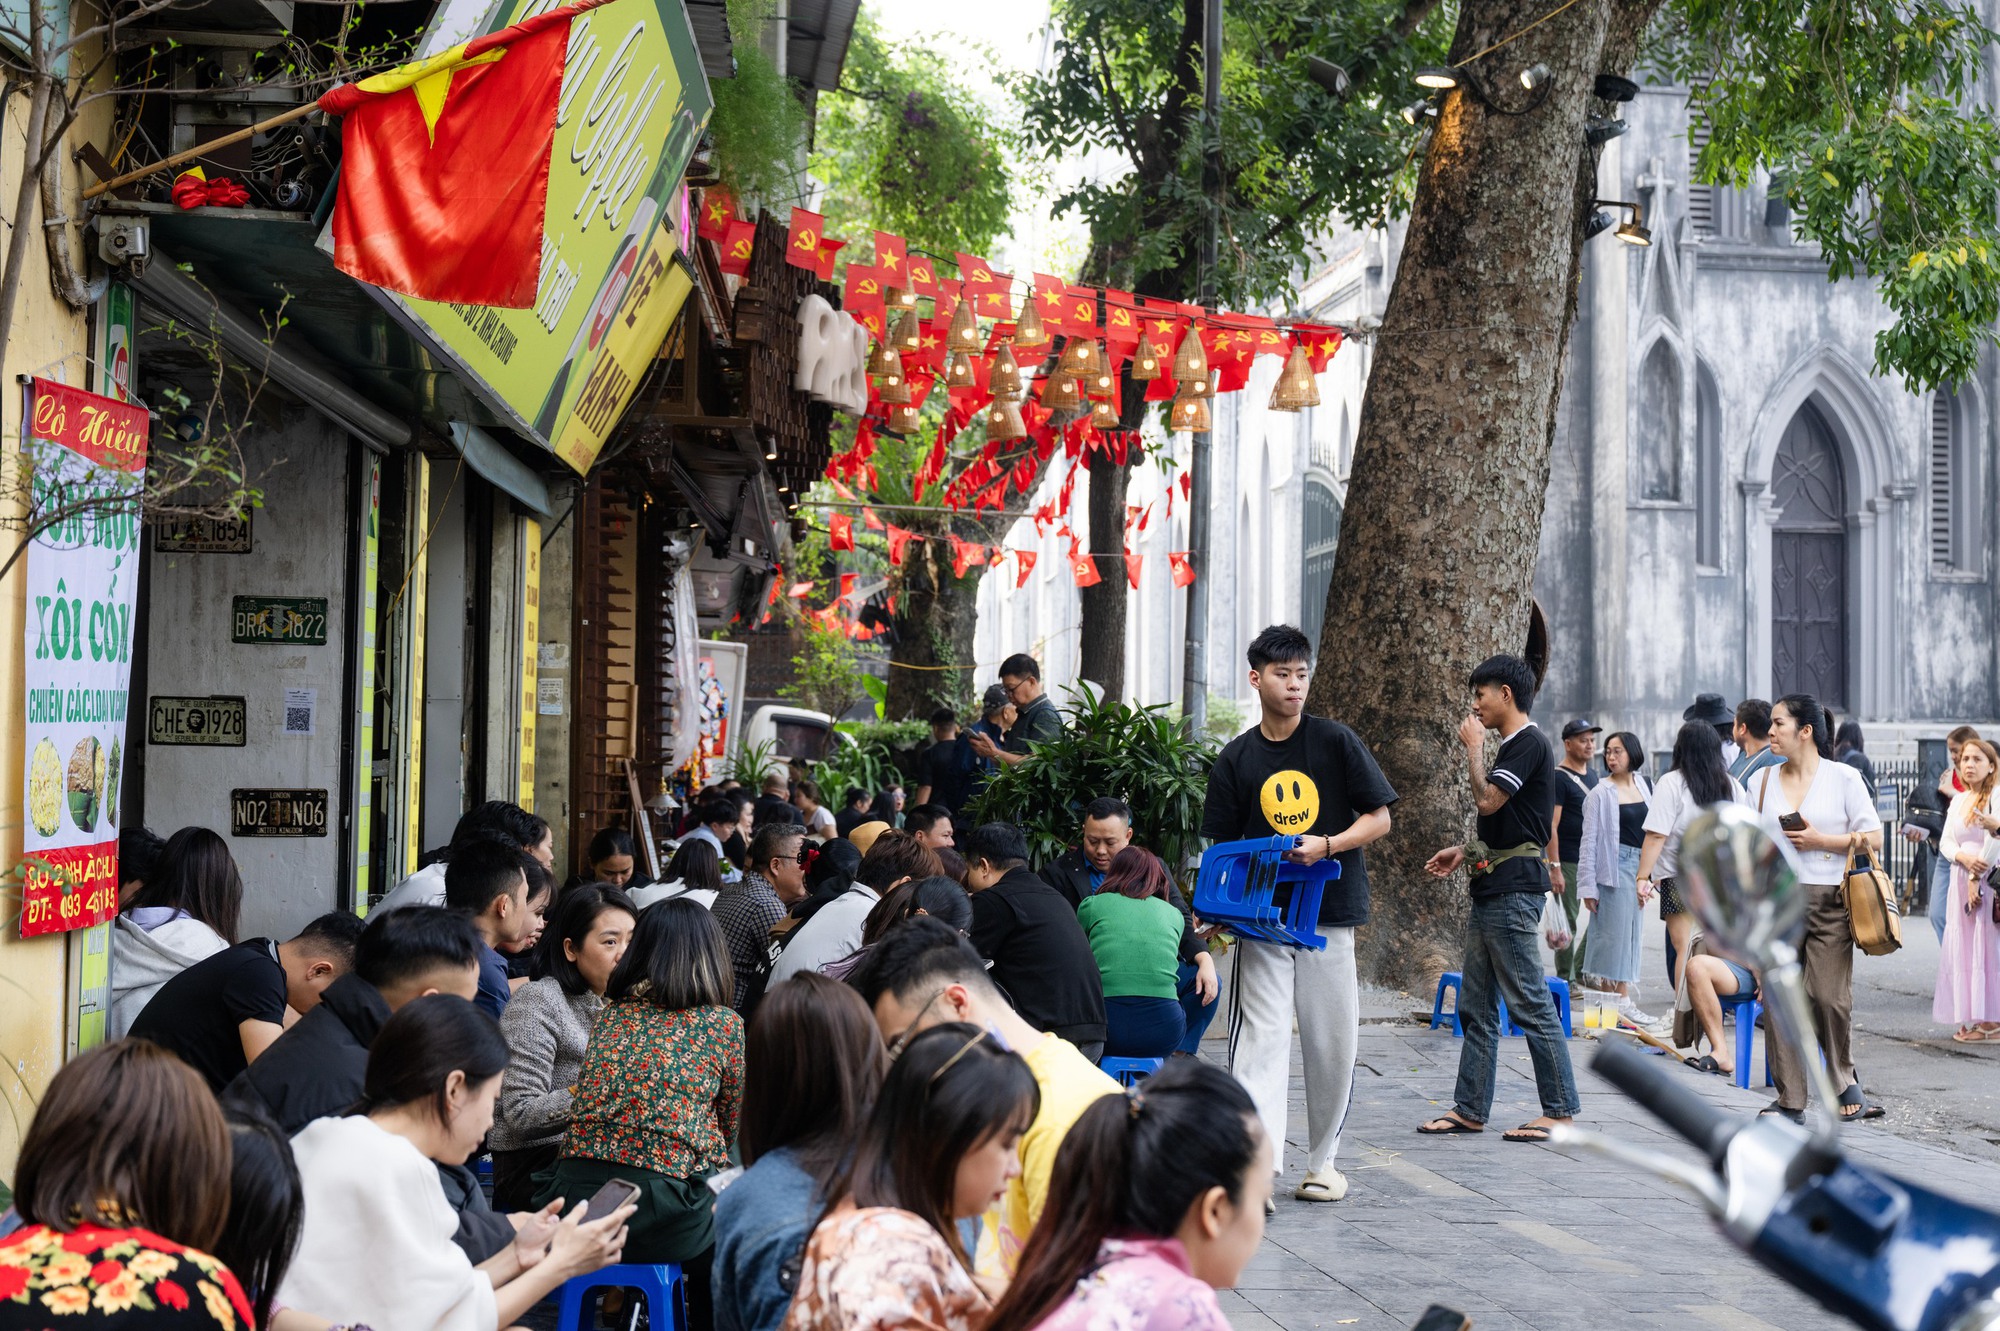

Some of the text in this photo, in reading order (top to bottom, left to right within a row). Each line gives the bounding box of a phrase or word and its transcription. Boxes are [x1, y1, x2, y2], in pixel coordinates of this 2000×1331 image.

[571, 20, 649, 232] Coffee
[471, 305, 488, 333] 2
[490, 322, 518, 366] CHUNG
[35, 394, 141, 455] Cô Hiếu
[208, 516, 248, 542] 1854
[36, 577, 82, 661] XÔI
[238, 601, 322, 612] JESUS BRAZIL
[236, 612, 324, 638] BRA 1822
[66, 681, 91, 723] CÁC
[154, 707, 242, 735] CHE 1928
[1273, 807, 1310, 826] drew
[53, 864, 64, 887] 2
[28, 897, 52, 924] ĐT:
